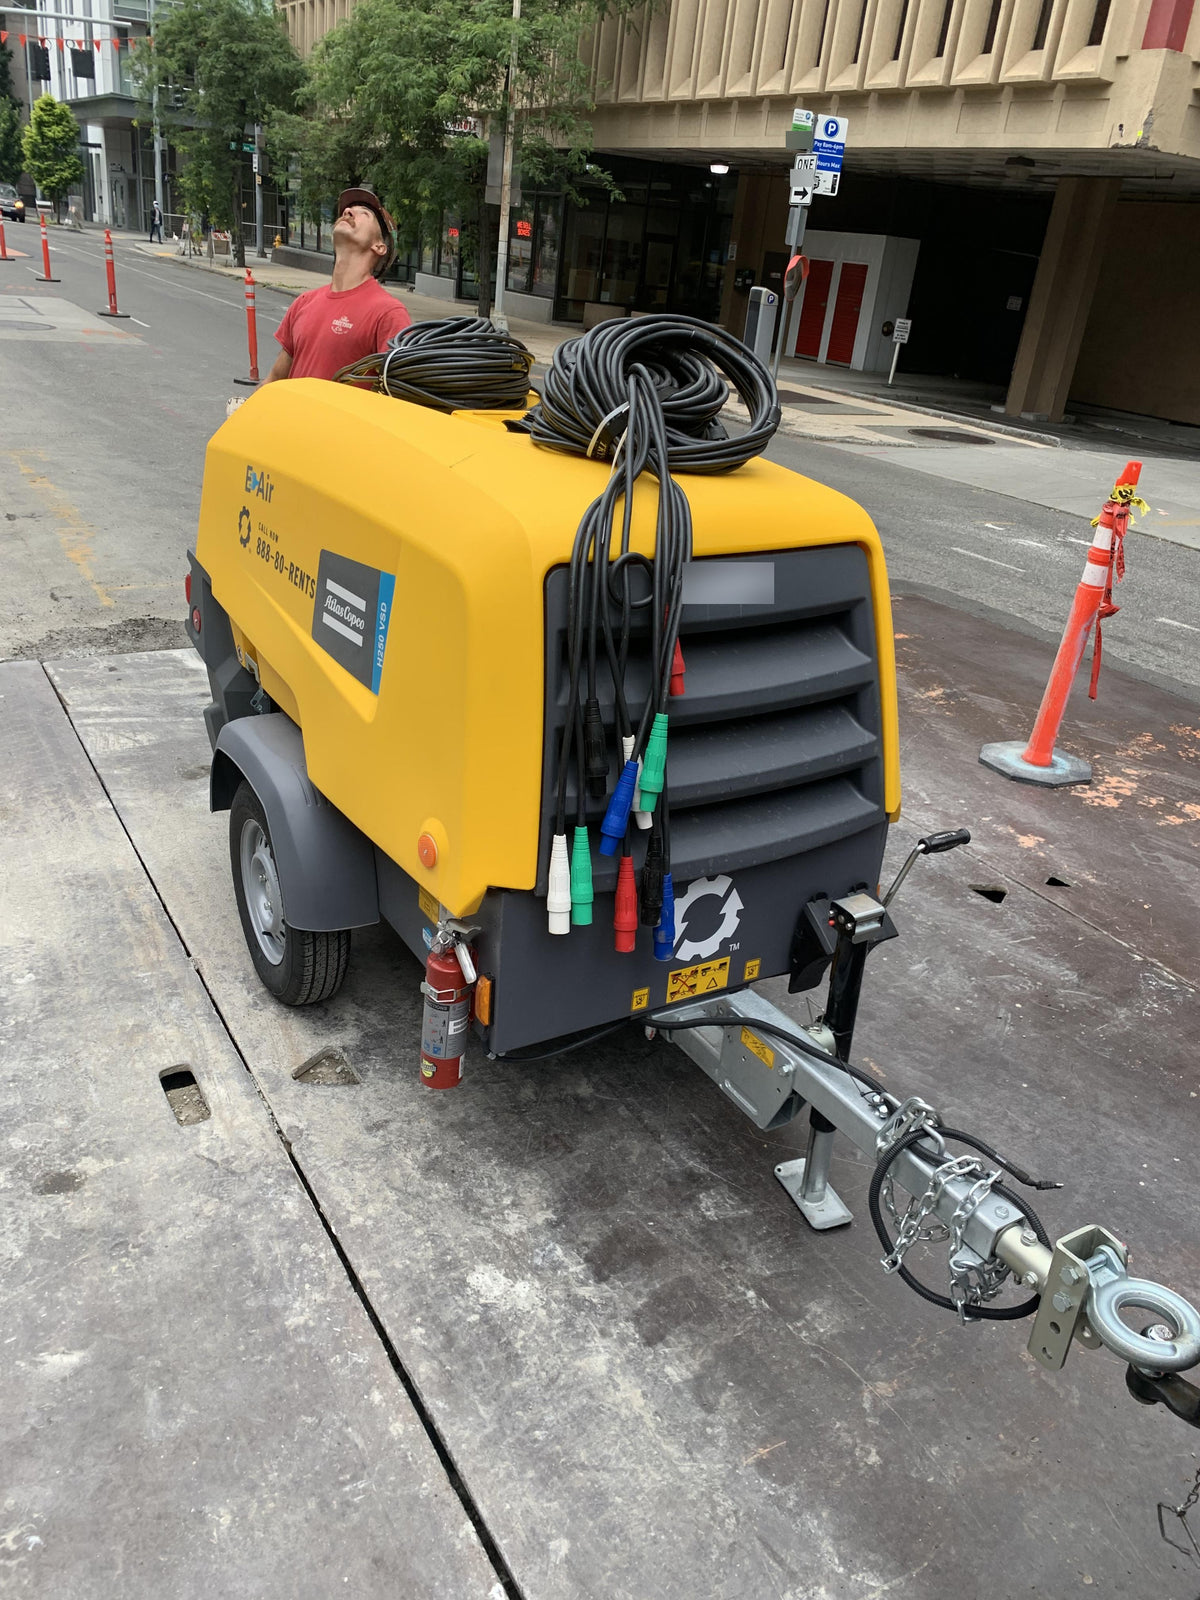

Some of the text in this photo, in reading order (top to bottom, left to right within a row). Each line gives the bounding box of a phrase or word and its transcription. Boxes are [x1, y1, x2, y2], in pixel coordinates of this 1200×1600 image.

[814, 140, 822, 148] Pay
[797, 159, 814, 170] ONE
[258, 522, 279, 543] CALL NOW
[256, 536, 316, 599] 888-80-RENTS
[376, 602, 387, 668] H250 VSD
[729, 942, 740, 952] TM
